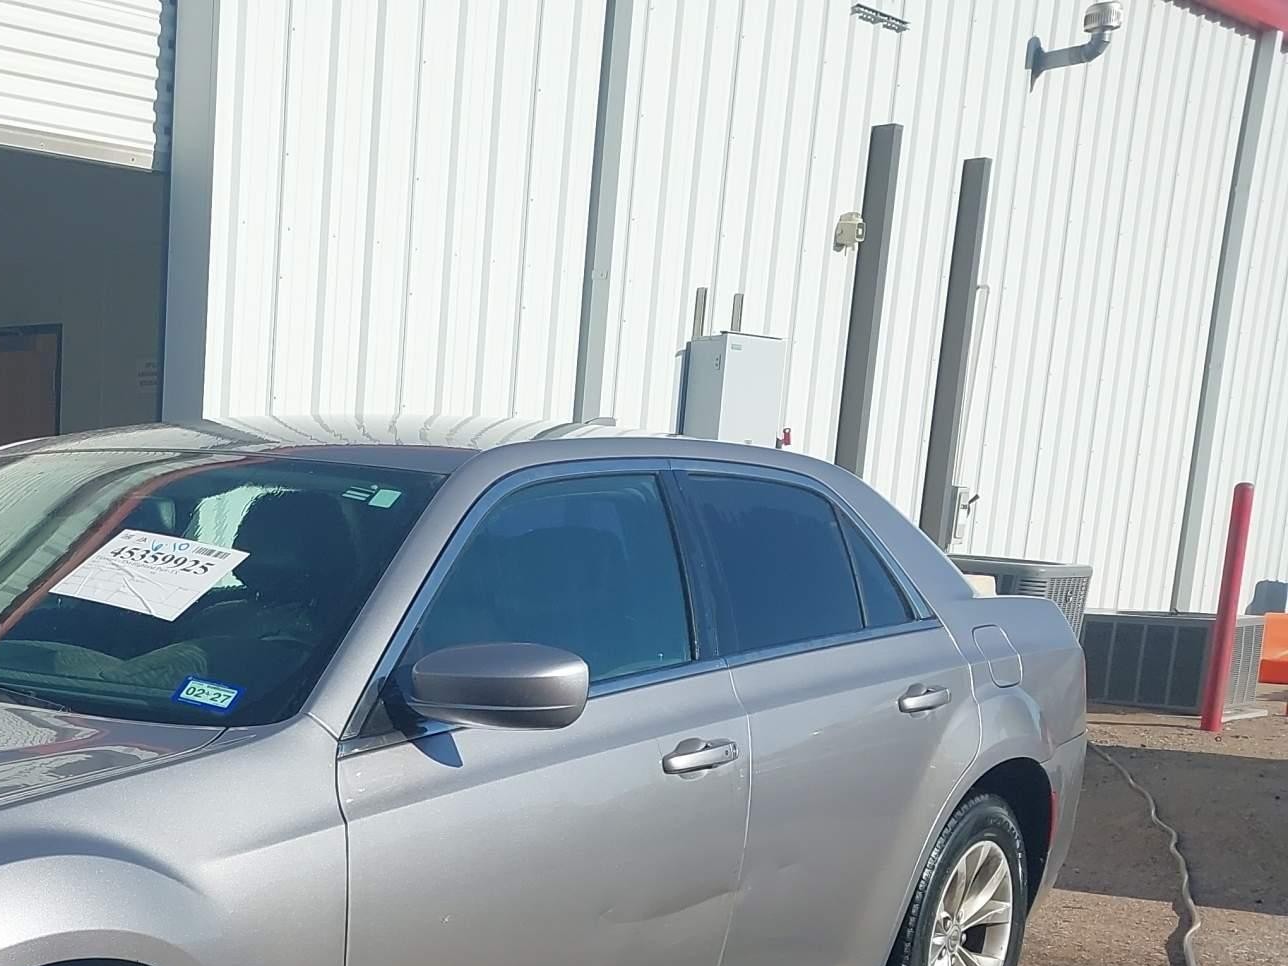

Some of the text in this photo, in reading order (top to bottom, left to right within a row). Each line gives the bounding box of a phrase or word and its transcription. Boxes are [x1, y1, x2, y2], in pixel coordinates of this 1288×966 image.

[111, 545, 215, 575] 45359925
[185, 687, 206, 698] 02
[210, 692, 232, 704] 27
